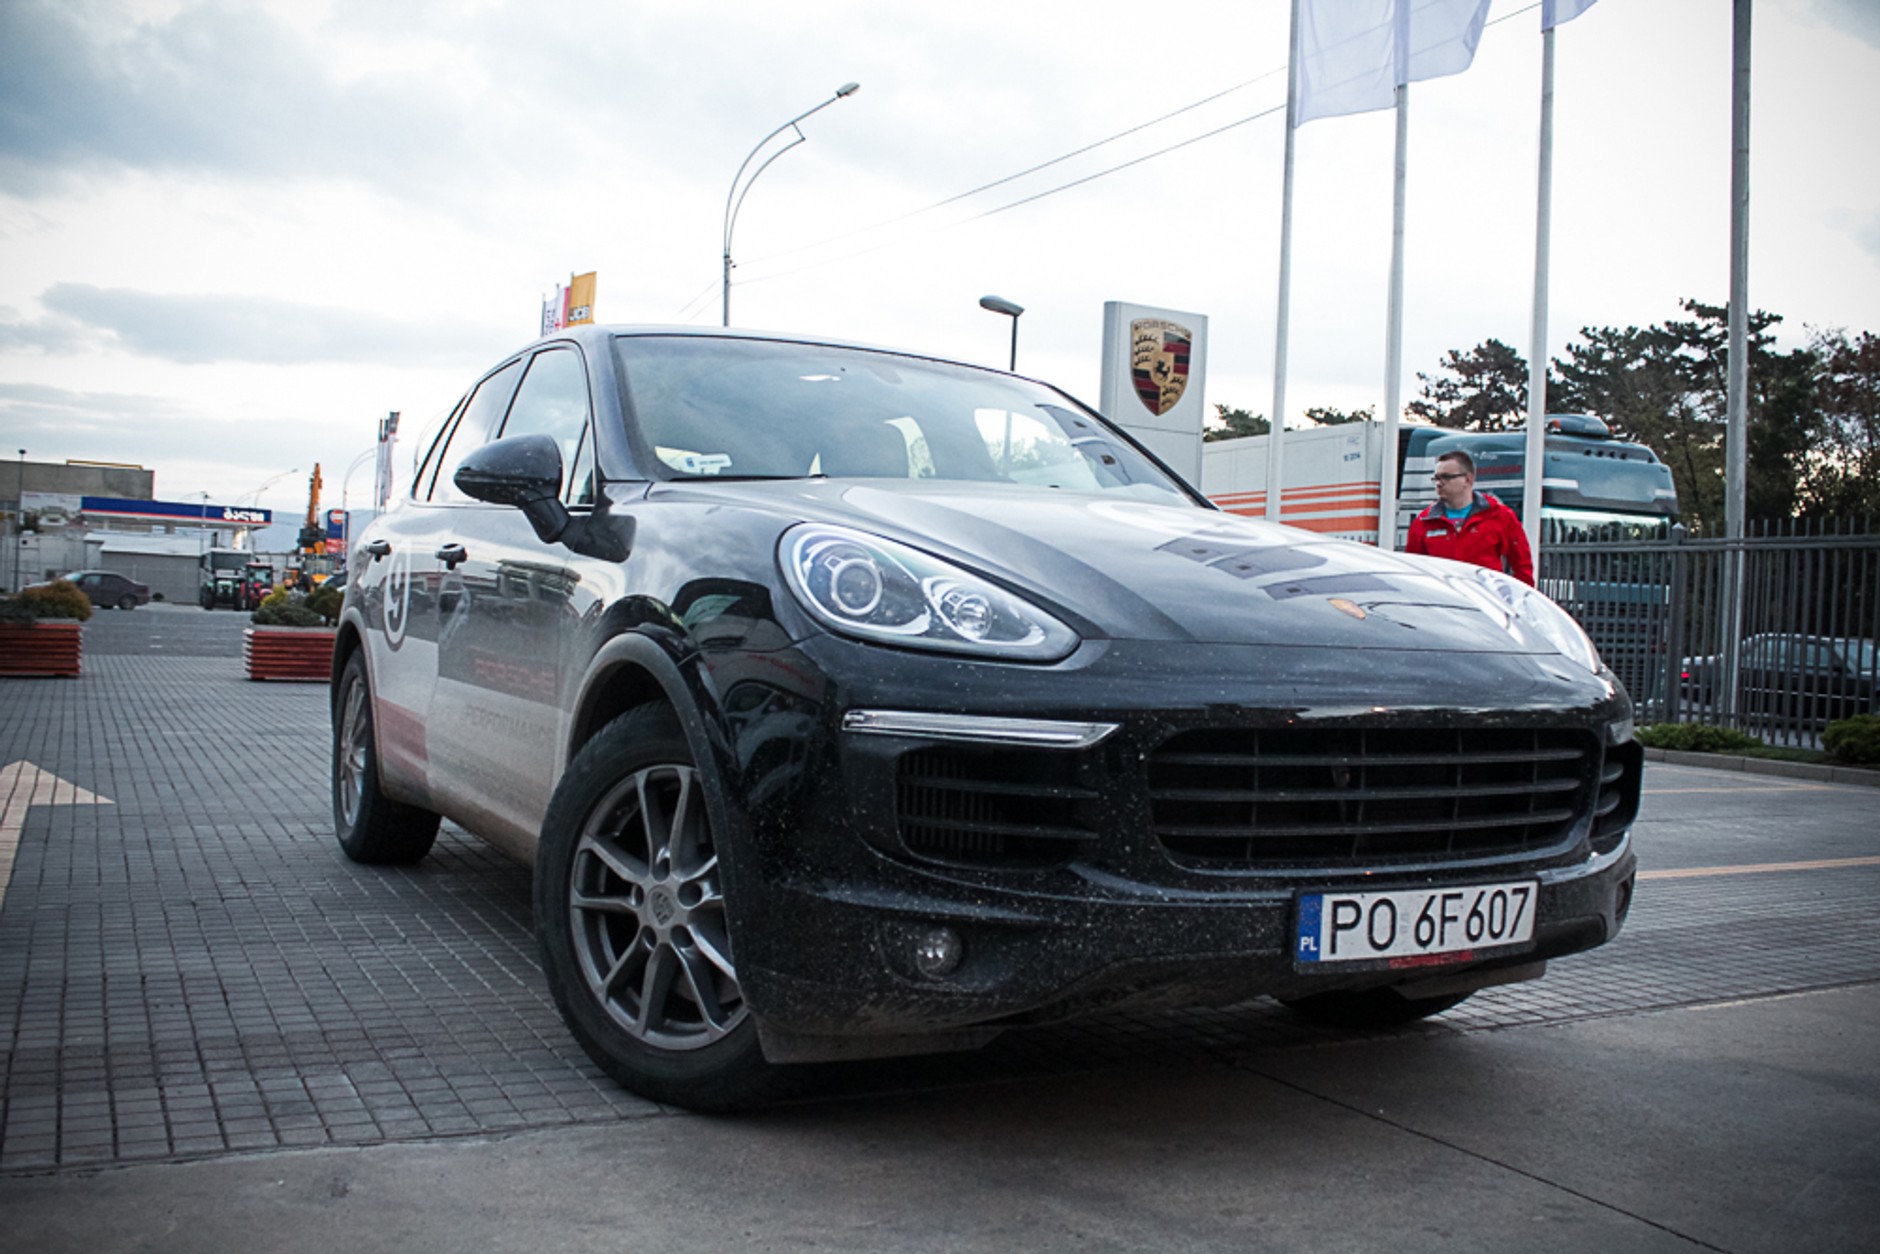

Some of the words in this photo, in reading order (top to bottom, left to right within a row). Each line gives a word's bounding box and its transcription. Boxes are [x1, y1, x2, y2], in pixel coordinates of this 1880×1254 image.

[1330, 898, 1397, 954] PO
[1413, 886, 1530, 949] 6F607
[1300, 936, 1318, 951] PL
